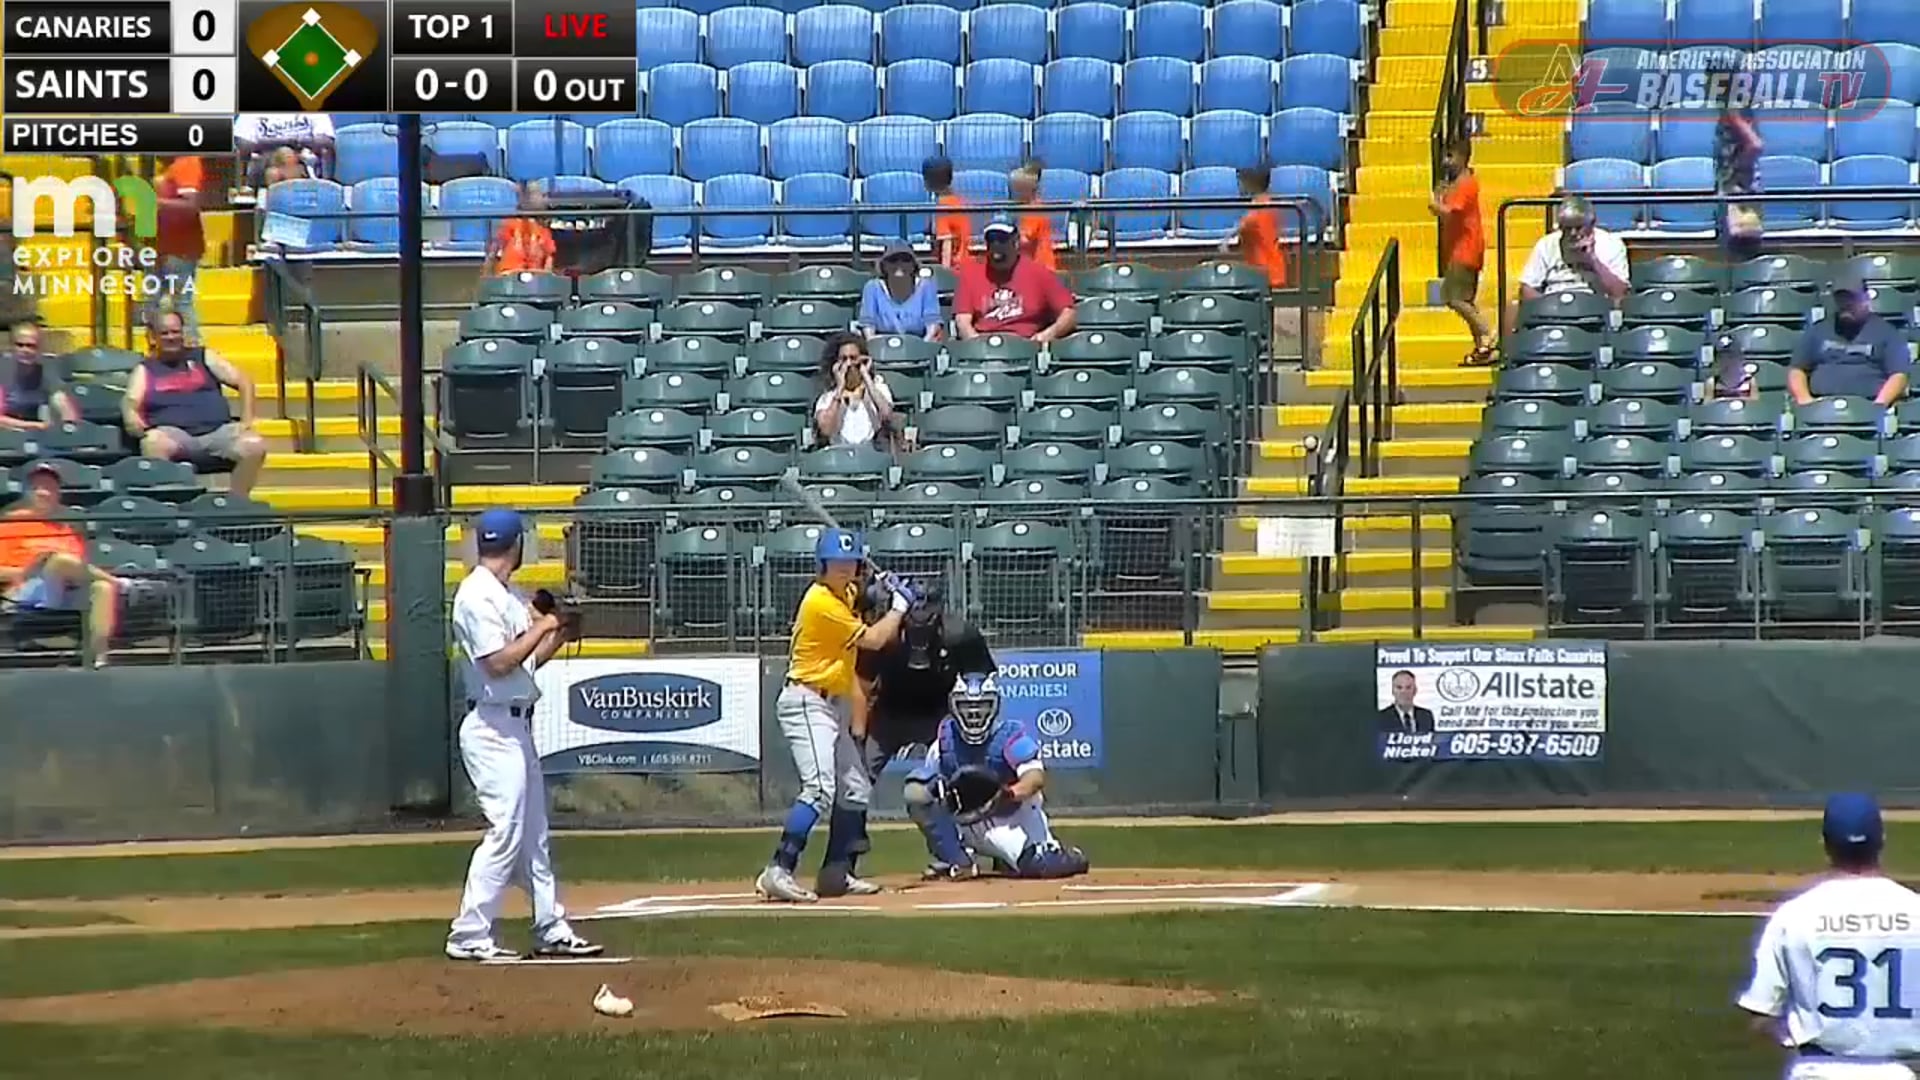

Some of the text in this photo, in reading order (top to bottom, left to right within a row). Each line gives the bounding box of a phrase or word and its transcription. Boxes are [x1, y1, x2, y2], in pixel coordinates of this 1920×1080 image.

[998, 663, 1076, 678] PORT OUR
[997, 683, 1068, 698] ANARIES!
[1481, 671, 1595, 698] Allstate
[579, 684, 712, 709] VanBuskirk
[601, 709, 690, 720] COMPANIES
[1387, 732, 1433, 745] Lloyd
[1450, 733, 1601, 757] 605-937-6500
[1383, 745, 1437, 759] Nickel
[1816, 913, 1911, 933] JUSTUS
[1815, 947, 1913, 1019] 31
